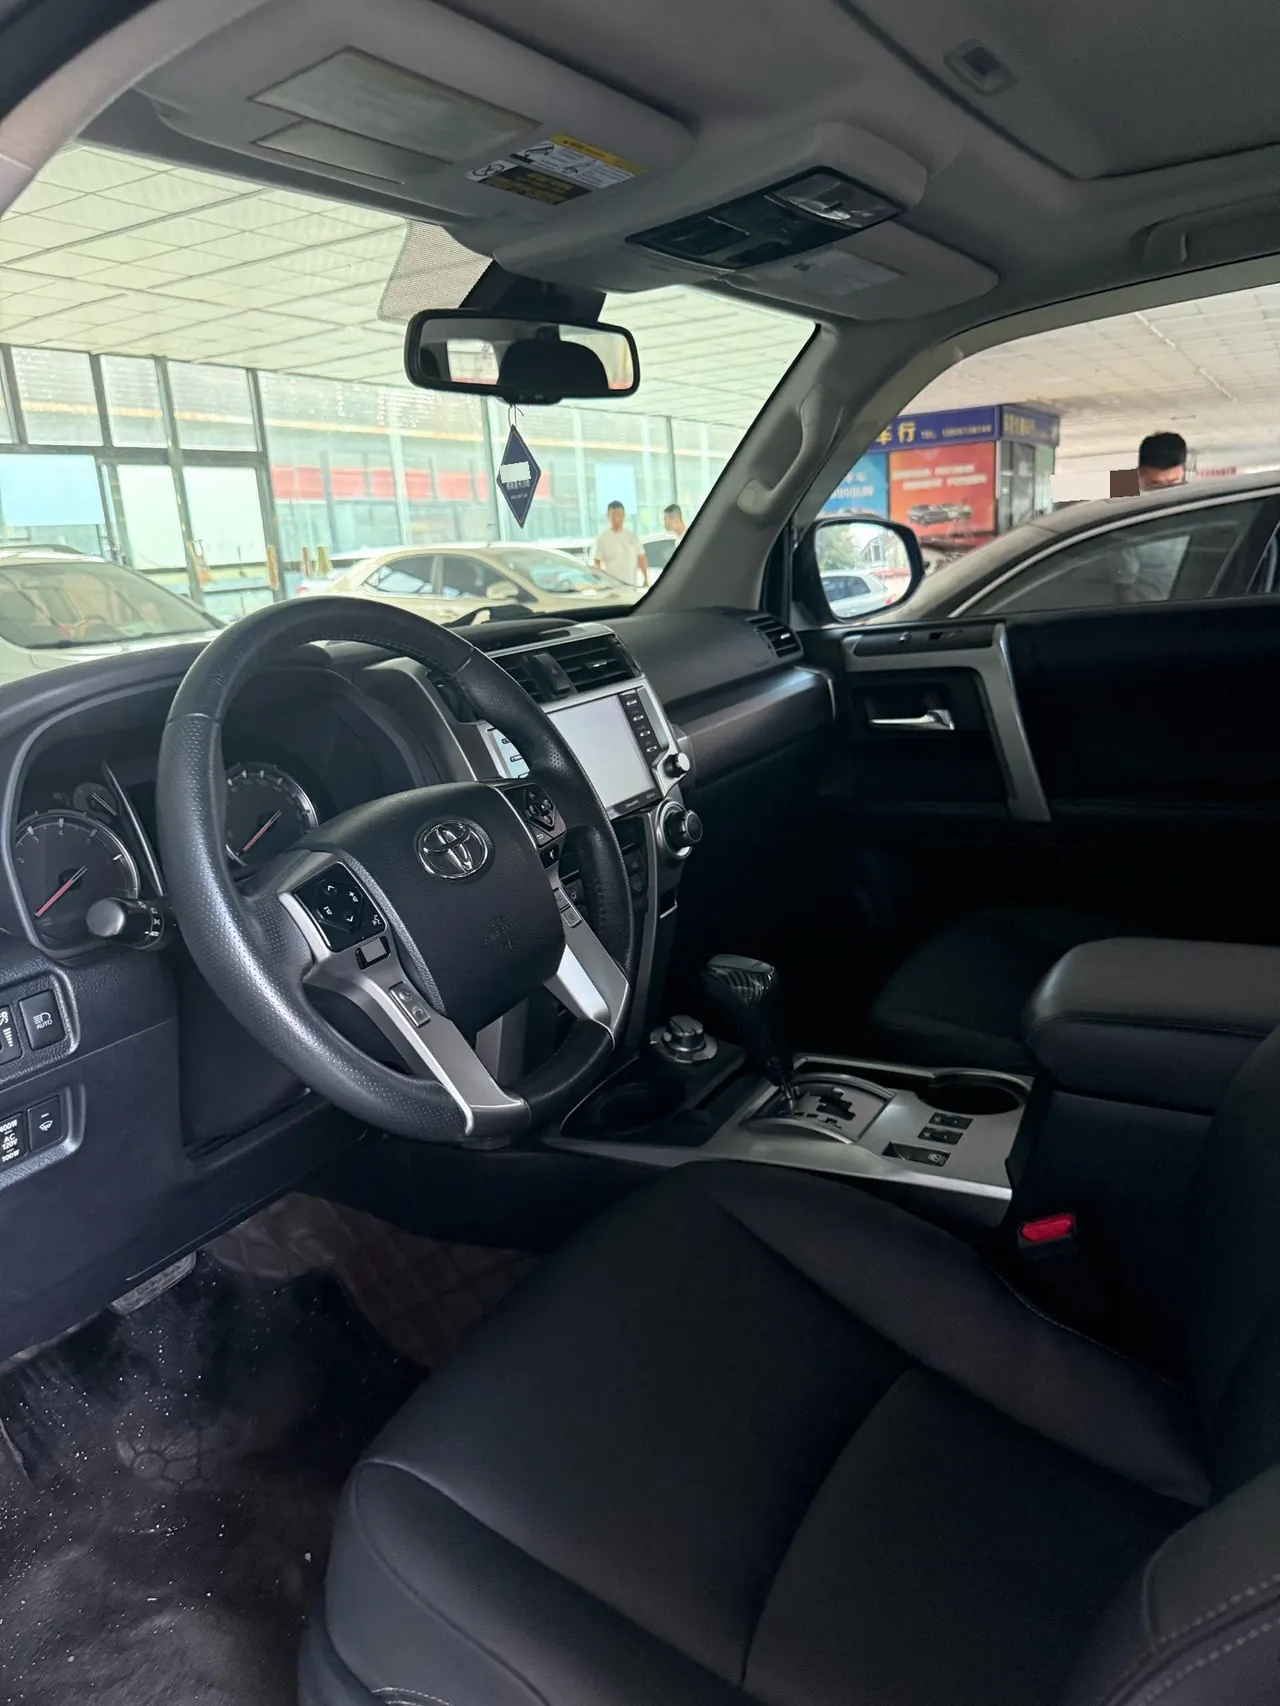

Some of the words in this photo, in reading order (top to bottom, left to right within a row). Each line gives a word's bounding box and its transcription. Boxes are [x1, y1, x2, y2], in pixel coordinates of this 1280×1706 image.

[36, 1019, 53, 1030] AUTO
[4, 1133, 16, 1143] AC
[1, 1138, 18, 1151] 120V
[1, 1149, 20, 1163] 100W
